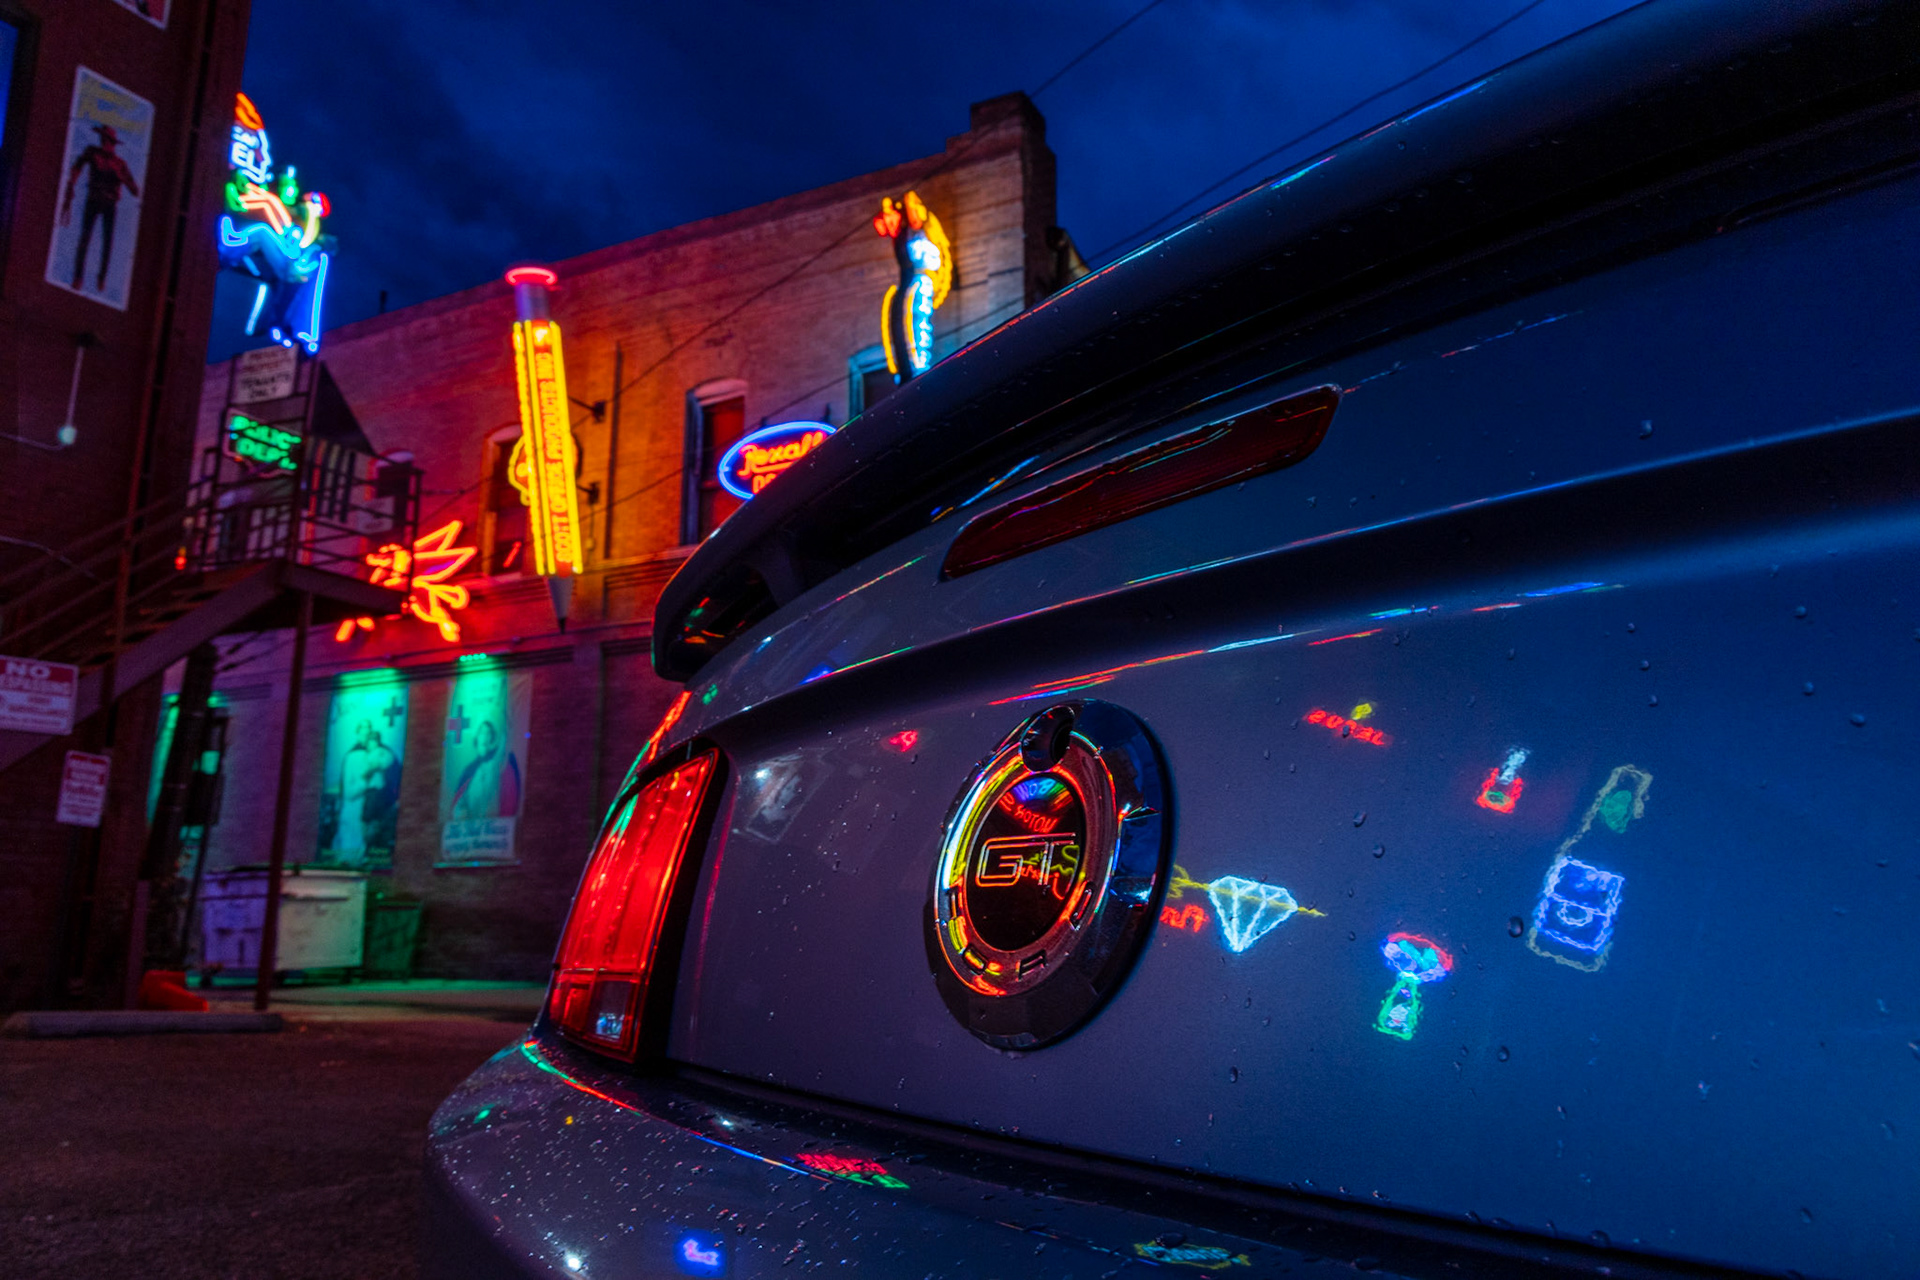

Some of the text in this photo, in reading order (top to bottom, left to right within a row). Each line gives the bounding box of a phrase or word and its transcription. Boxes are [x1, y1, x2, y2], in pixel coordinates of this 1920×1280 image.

[551, 514, 573, 563] SCOTT
[6, 661, 50, 679] NO
[975, 832, 1076, 887] GT
